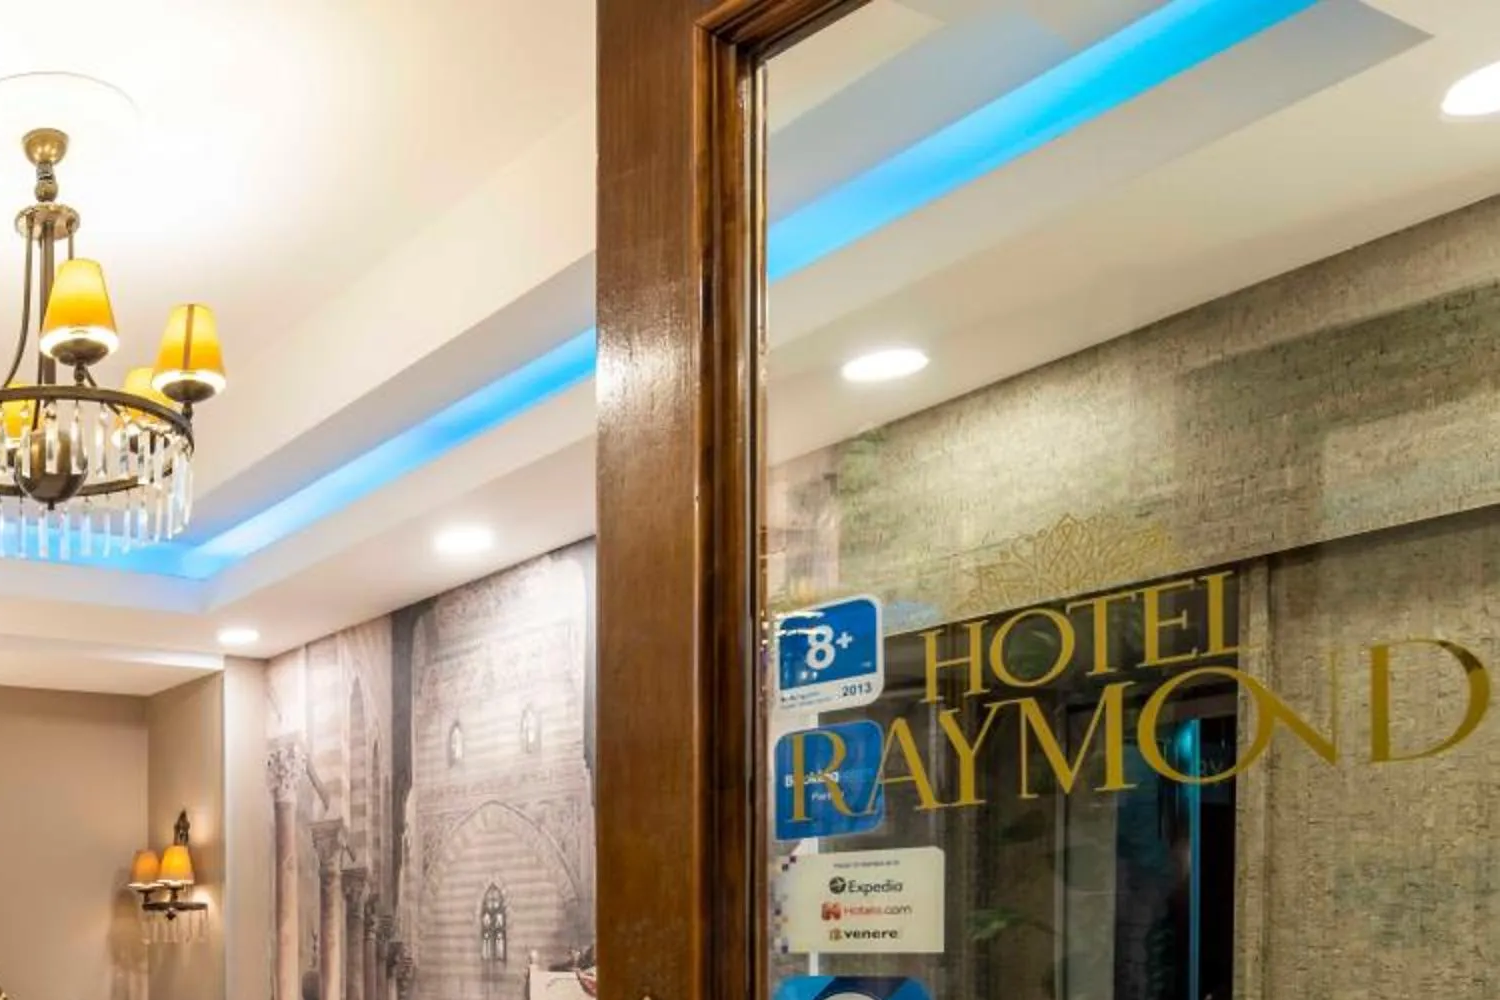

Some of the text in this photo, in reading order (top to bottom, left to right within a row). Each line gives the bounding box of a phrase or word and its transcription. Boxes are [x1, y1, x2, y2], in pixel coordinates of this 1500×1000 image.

[919, 570, 1264, 704] HOTEL
[841, 681, 873, 698] 2013
[783, 638, 1492, 823] RAYMOND
[847, 879, 904, 896] Expedia
[843, 903, 913, 916] Hotels.com
[843, 929, 899, 940] venere
